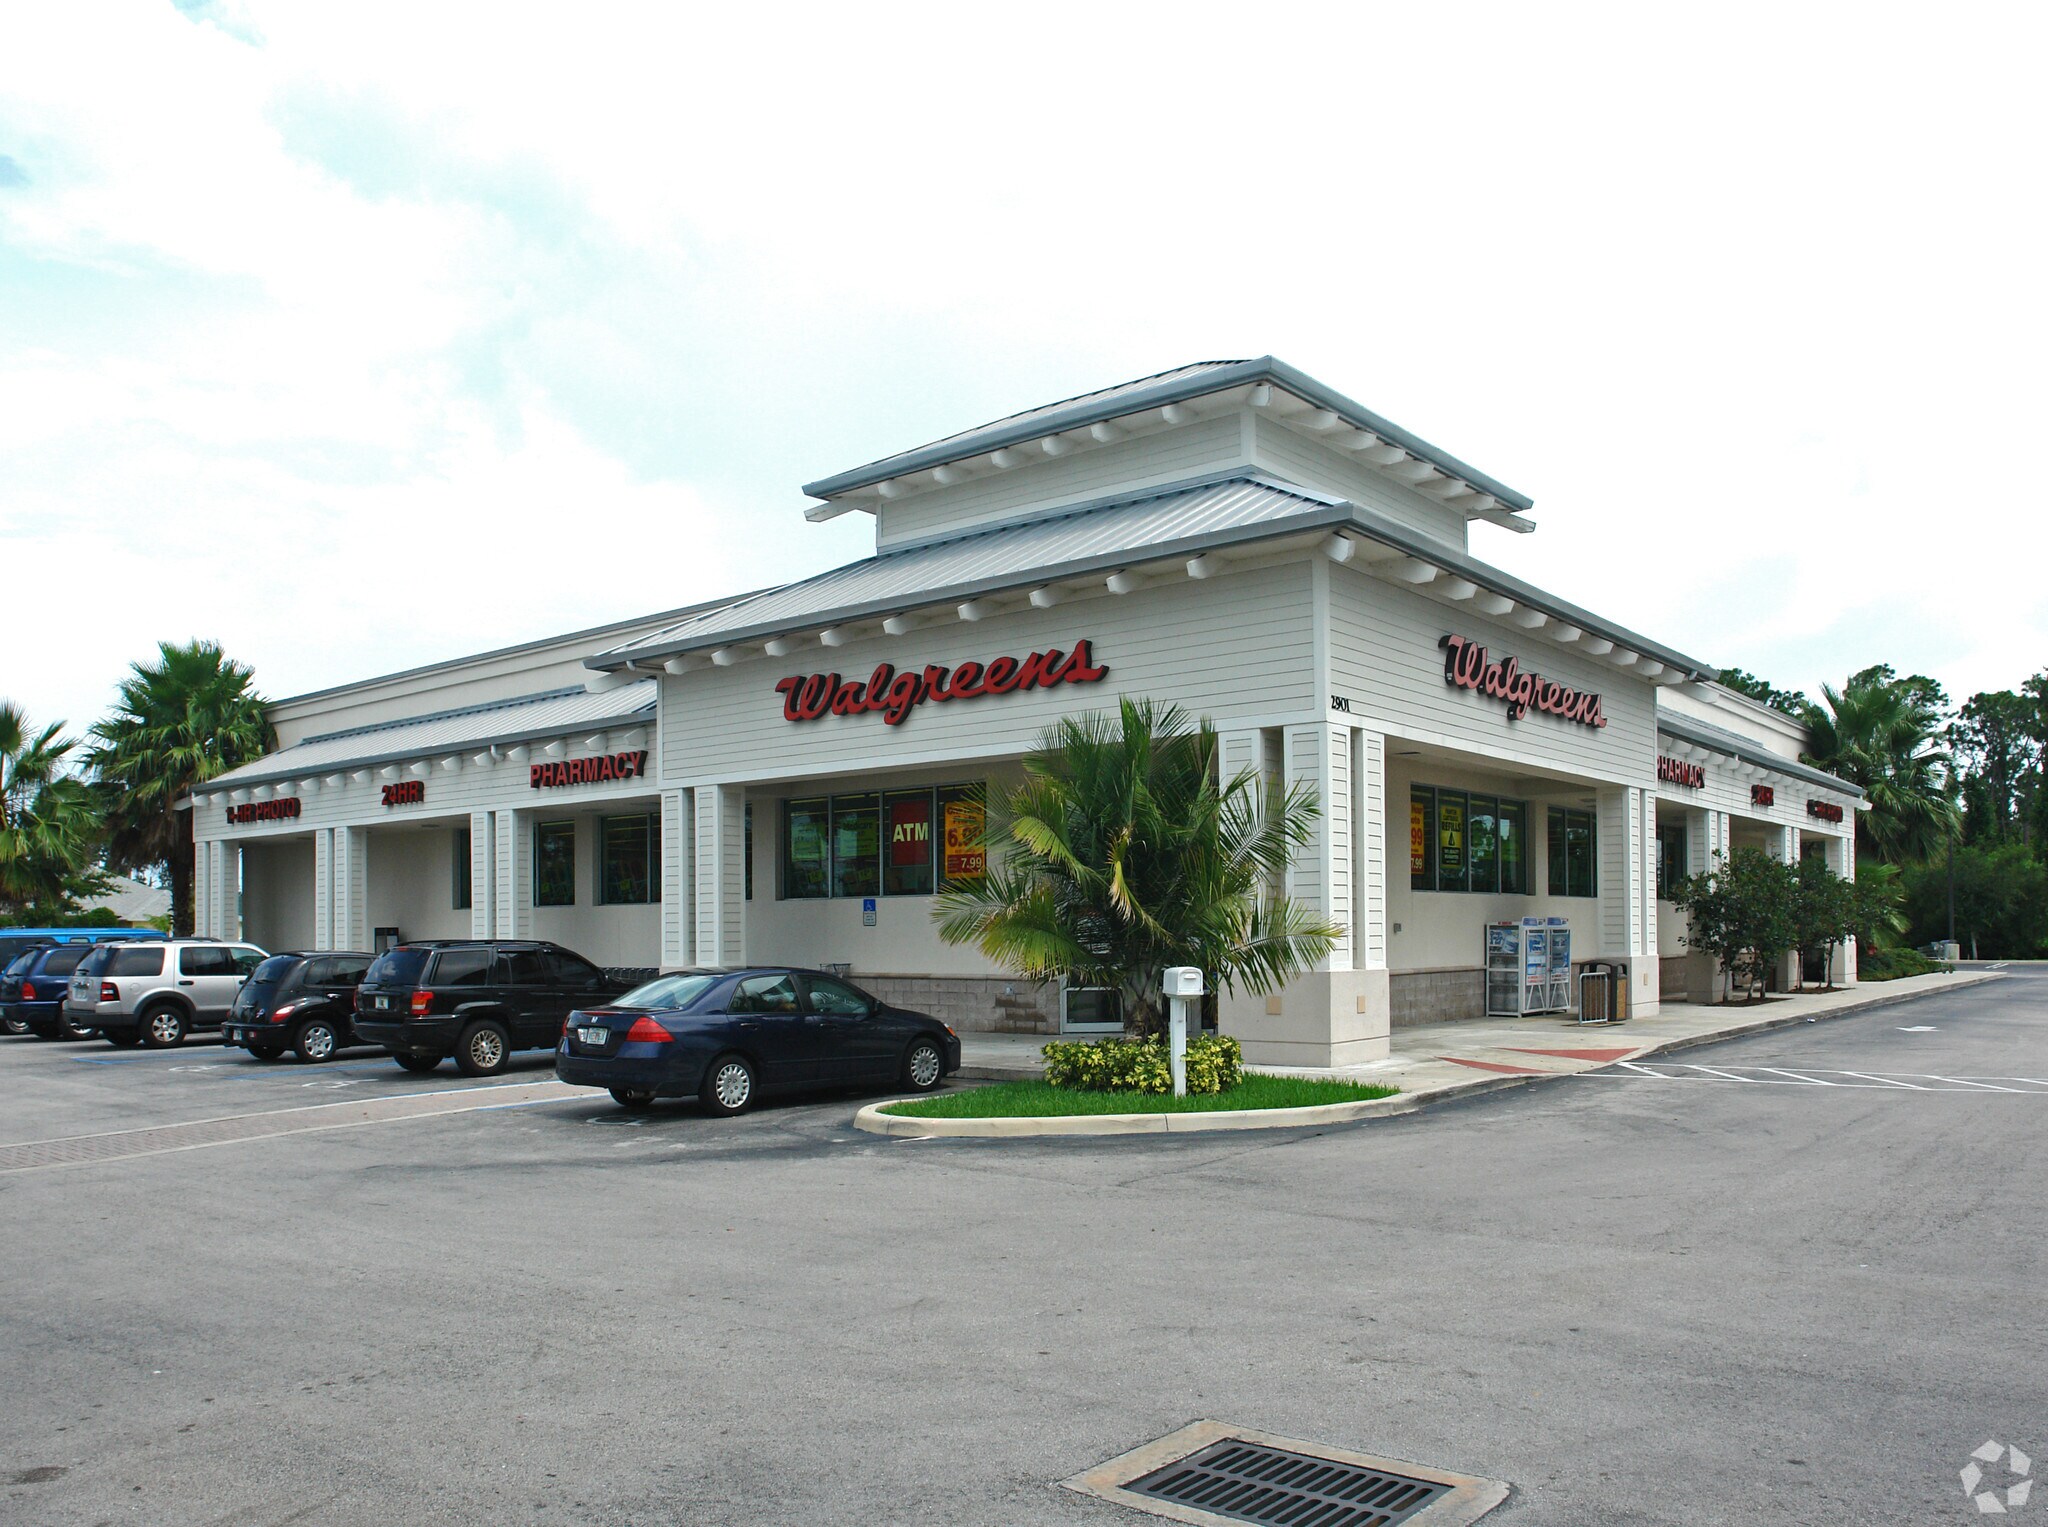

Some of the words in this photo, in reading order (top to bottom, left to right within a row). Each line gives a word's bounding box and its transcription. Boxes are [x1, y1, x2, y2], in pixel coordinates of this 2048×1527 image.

[775, 639, 1109, 725] Walgreens
[1438, 634, 1607, 728] Walgreens
[1331, 695, 1350, 713] 2901
[531, 750, 648, 788] PHARMACY
[1657, 754, 1706, 789] PHARMACY
[382, 780, 424, 805] 24HR
[256, 797, 301, 821] PHOTO
[892, 822, 929, 842] ATM
[961, 857, 982, 870] 7.99
